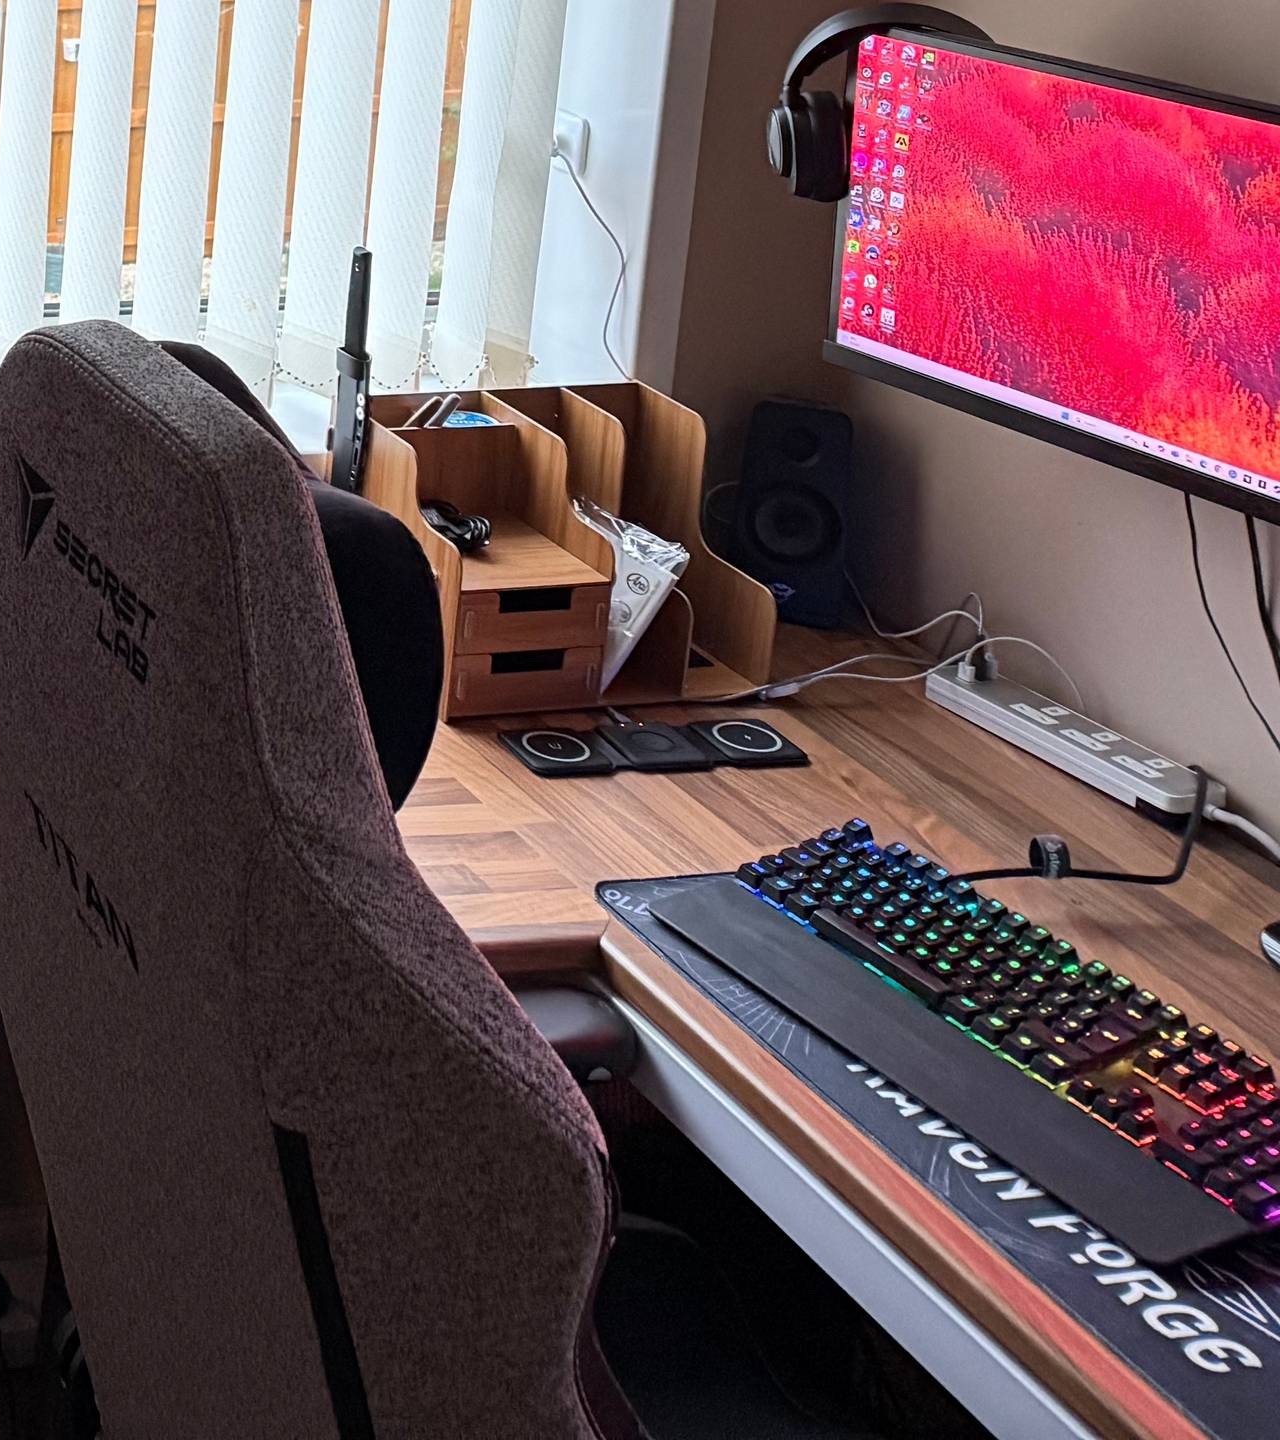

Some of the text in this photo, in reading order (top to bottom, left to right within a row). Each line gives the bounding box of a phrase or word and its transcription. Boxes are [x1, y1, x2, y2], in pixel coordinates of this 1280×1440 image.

[53, 520, 157, 641] SECRET
[96, 609, 149, 685] LAB
[24, 790, 140, 976] TITAN
[1028, 1213, 1263, 1375] FORGE
